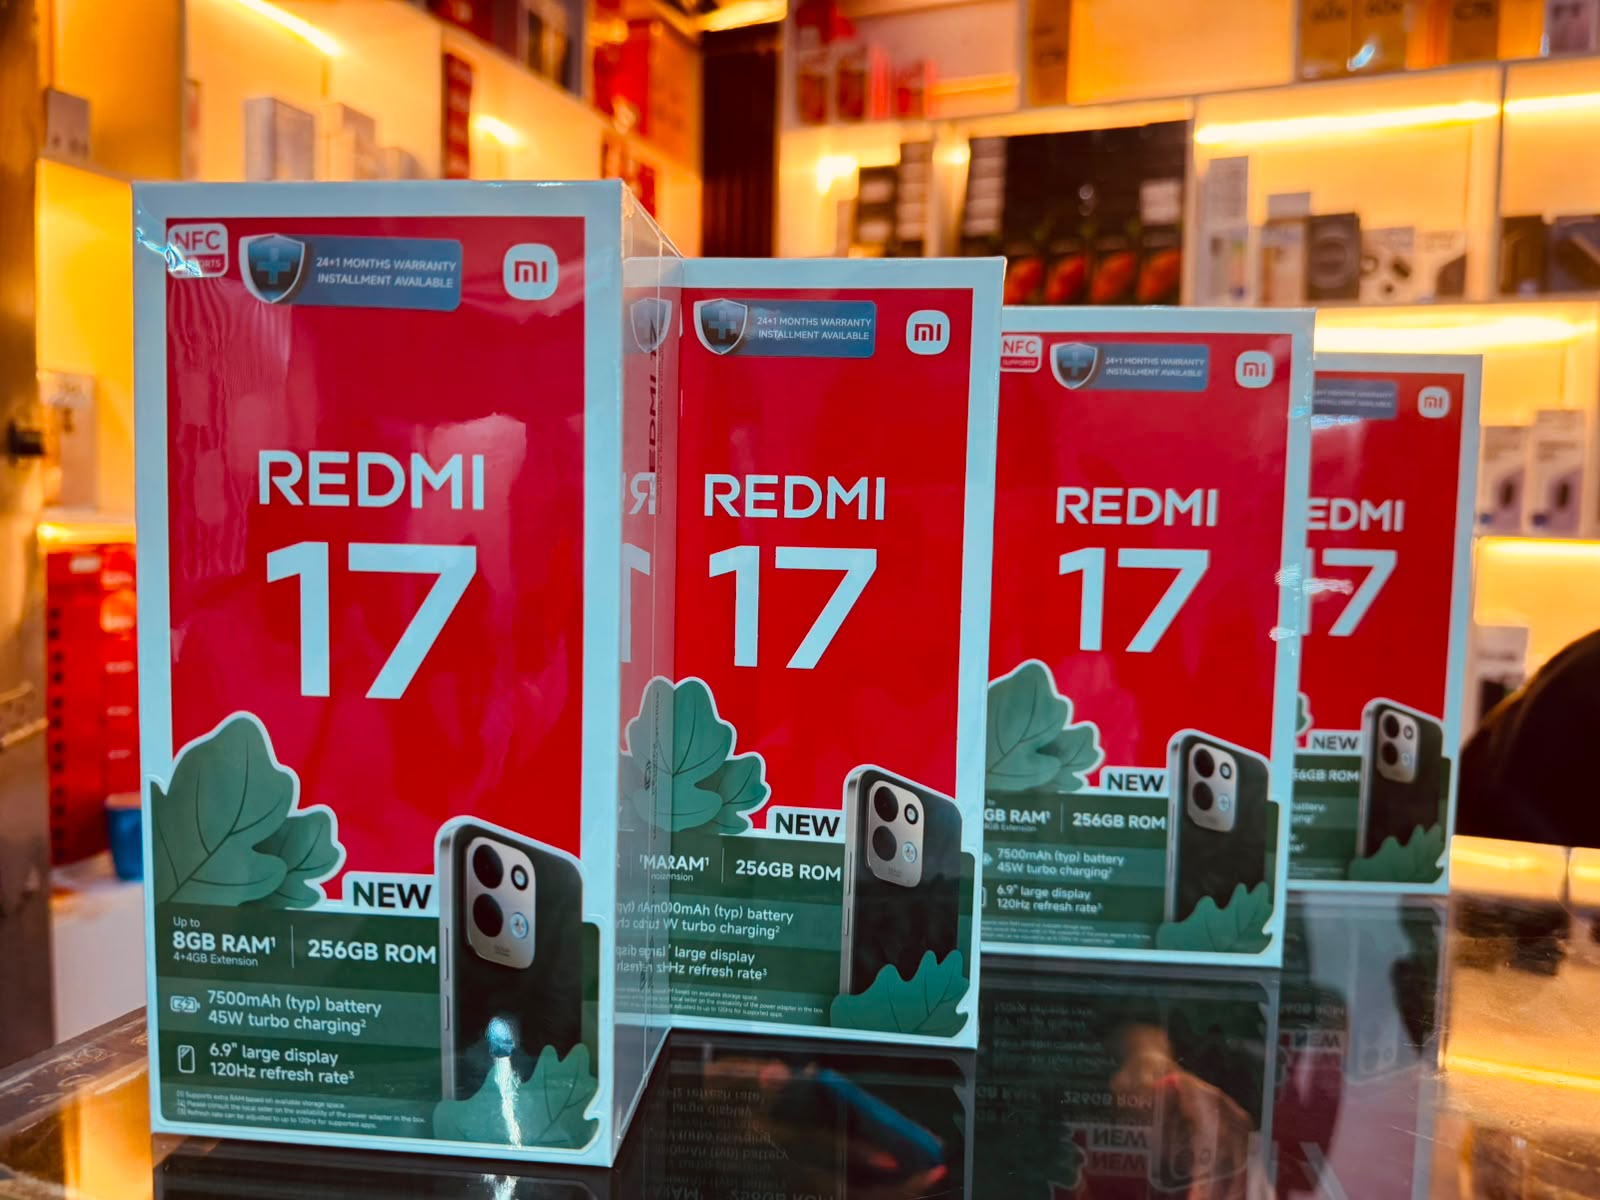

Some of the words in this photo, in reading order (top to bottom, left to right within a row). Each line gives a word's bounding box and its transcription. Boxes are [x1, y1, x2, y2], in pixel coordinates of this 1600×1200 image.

[174, 229, 221, 251] NFC
[316, 257, 341, 267] 24+1
[344, 257, 391, 270] MONTHS
[394, 259, 457, 273] WARRANTY
[317, 273, 391, 286] INSTALLMENT
[395, 275, 454, 289] AVAILABLE
[757, 316, 778, 327] 24+1
[779, 316, 819, 327] MONTHS
[820, 317, 872, 329] WARRANTY
[758, 329, 819, 340] INSTALLMENT
[821, 330, 869, 341] AVAILABLE
[1003, 340, 1037, 354] NFC
[1105, 357, 1124, 365] 24+1
[1125, 357, 1158, 365] MONTHS
[1160, 358, 1205, 367] WARRANTY
[1106, 368, 1159, 376] INSTALLMENT
[1160, 369, 1203, 377] AVAILABLE
[258, 450, 485, 511] REDMI
[704, 473, 885, 520] REDMI
[1055, 486, 1218, 527] REDMI
[1306, 498, 1405, 532] EDMI
[708, 546, 878, 672] 17
[1058, 547, 1209, 653] 17
[265, 542, 478, 700] 17
[1312, 735, 1359, 750] NEW
[1107, 773, 1164, 792] NEW
[1328, 769, 1360, 782] ROM
[775, 813, 840, 837] NEW
[1072, 812, 1123, 828] 256GB
[1128, 815, 1166, 829] ROM
[997, 848, 1051, 861] 7500mAh
[1055, 850, 1081, 864] (typ)
[1084, 852, 1124, 866] battery
[735, 859, 793, 879] 256GB
[799, 864, 841, 882] ROM
[997, 862, 1023, 873] 45W
[1026, 864, 1056, 875] turbo
[353, 881, 432, 910] NEW
[1020, 885, 1048, 899] large
[1051, 888, 1091, 901] display
[997, 898, 1030, 909] 120Hz
[1033, 900, 1072, 911] refresh
[173, 917, 188, 929] Up
[190, 917, 201, 927] to
[714, 904, 743, 919] (typ)
[747, 907, 794, 925] battery
[682, 919, 716, 933] turbo
[172, 931, 216, 951] 8GB
[173, 952, 208, 963] 4+4GB
[210, 955, 259, 967] Extension
[307, 939, 379, 961] 256GB
[384, 943, 437, 964] ROM
[675, 946, 706, 961] large
[710, 948, 755, 965] display
[689, 963, 734, 978] refresh
[207, 989, 281, 1009] 7500mAh
[286, 992, 321, 1014] (typ)
[324, 998, 382, 1018] battery
[208, 1010, 243, 1025] 45W
[248, 1014, 289, 1029] turbo
[242, 1044, 281, 1062] large
[284, 1046, 339, 1067] display
[210, 1062, 256, 1079] 120Hz
[260, 1065, 315, 1082] refresh
